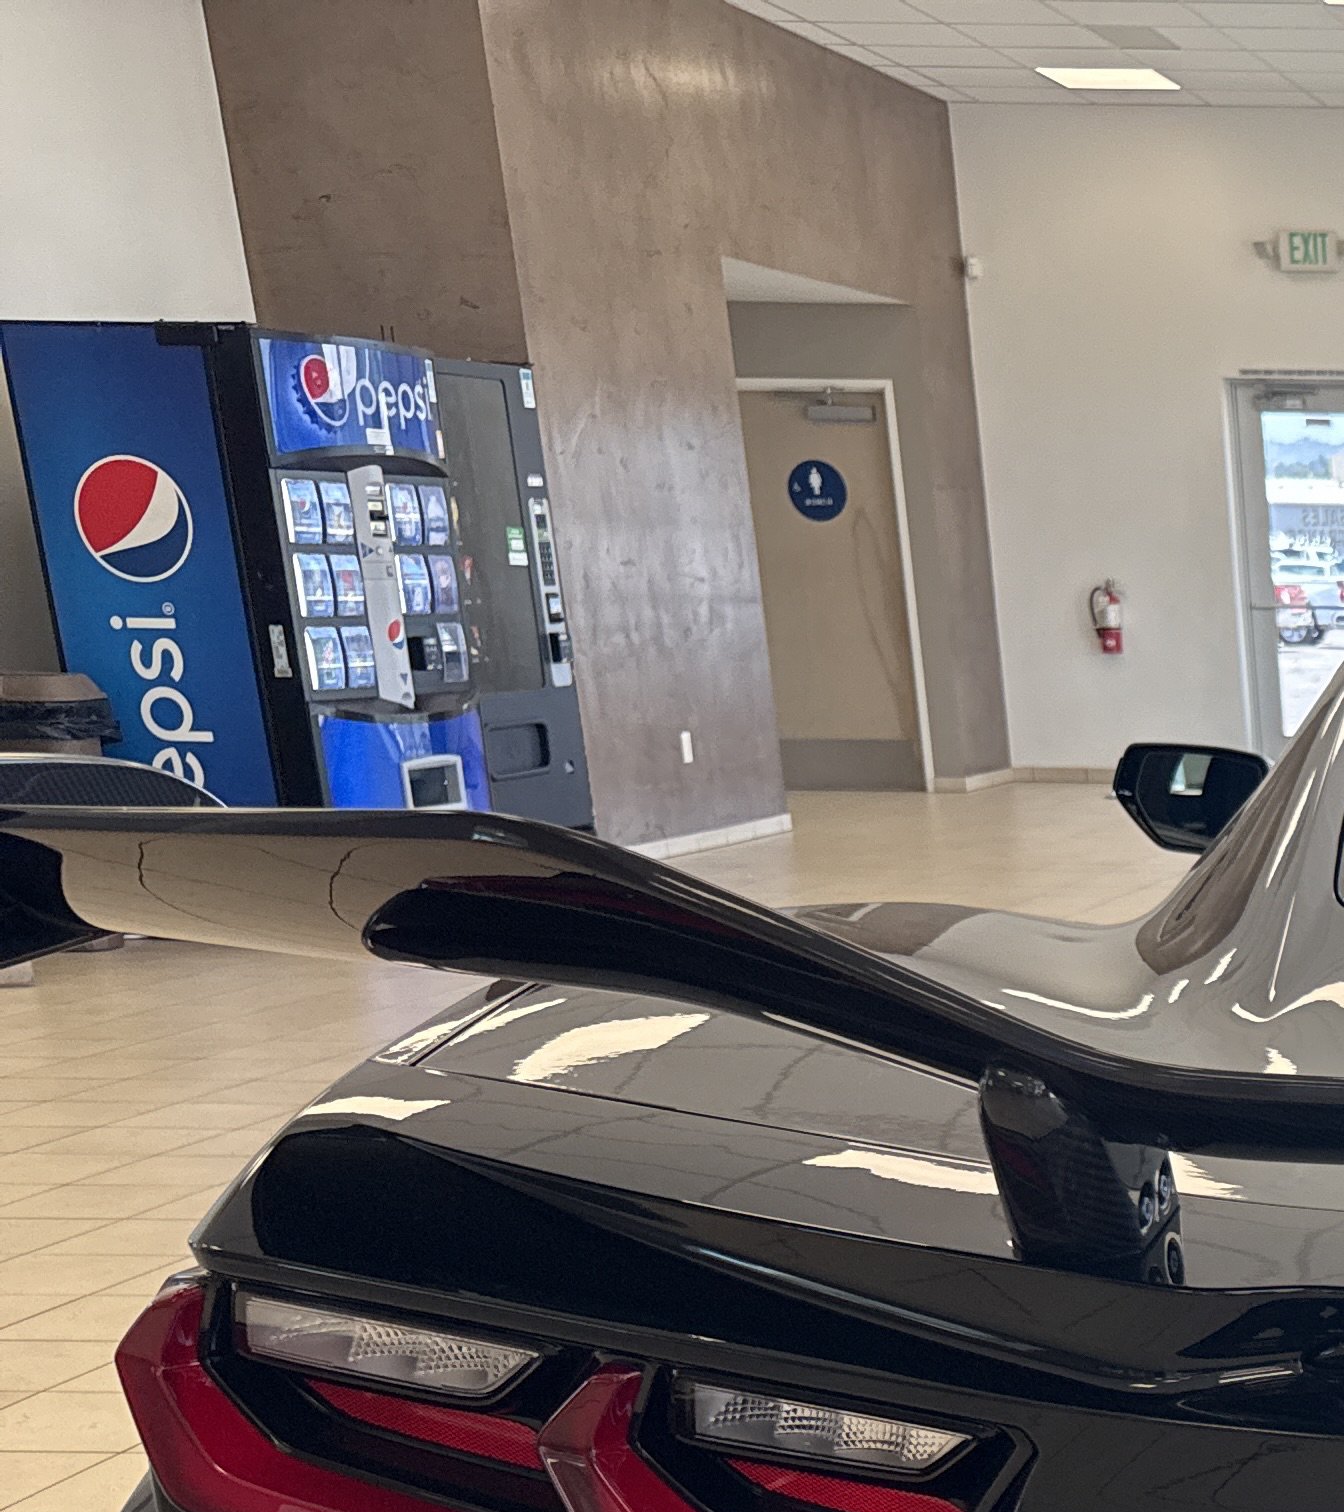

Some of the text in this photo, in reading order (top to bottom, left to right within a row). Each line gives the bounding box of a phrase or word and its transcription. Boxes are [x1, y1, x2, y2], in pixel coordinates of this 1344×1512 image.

[1288, 231, 1328, 265] EXIT
[355, 377, 434, 431] pepsi
[109, 613, 215, 789] epsi
